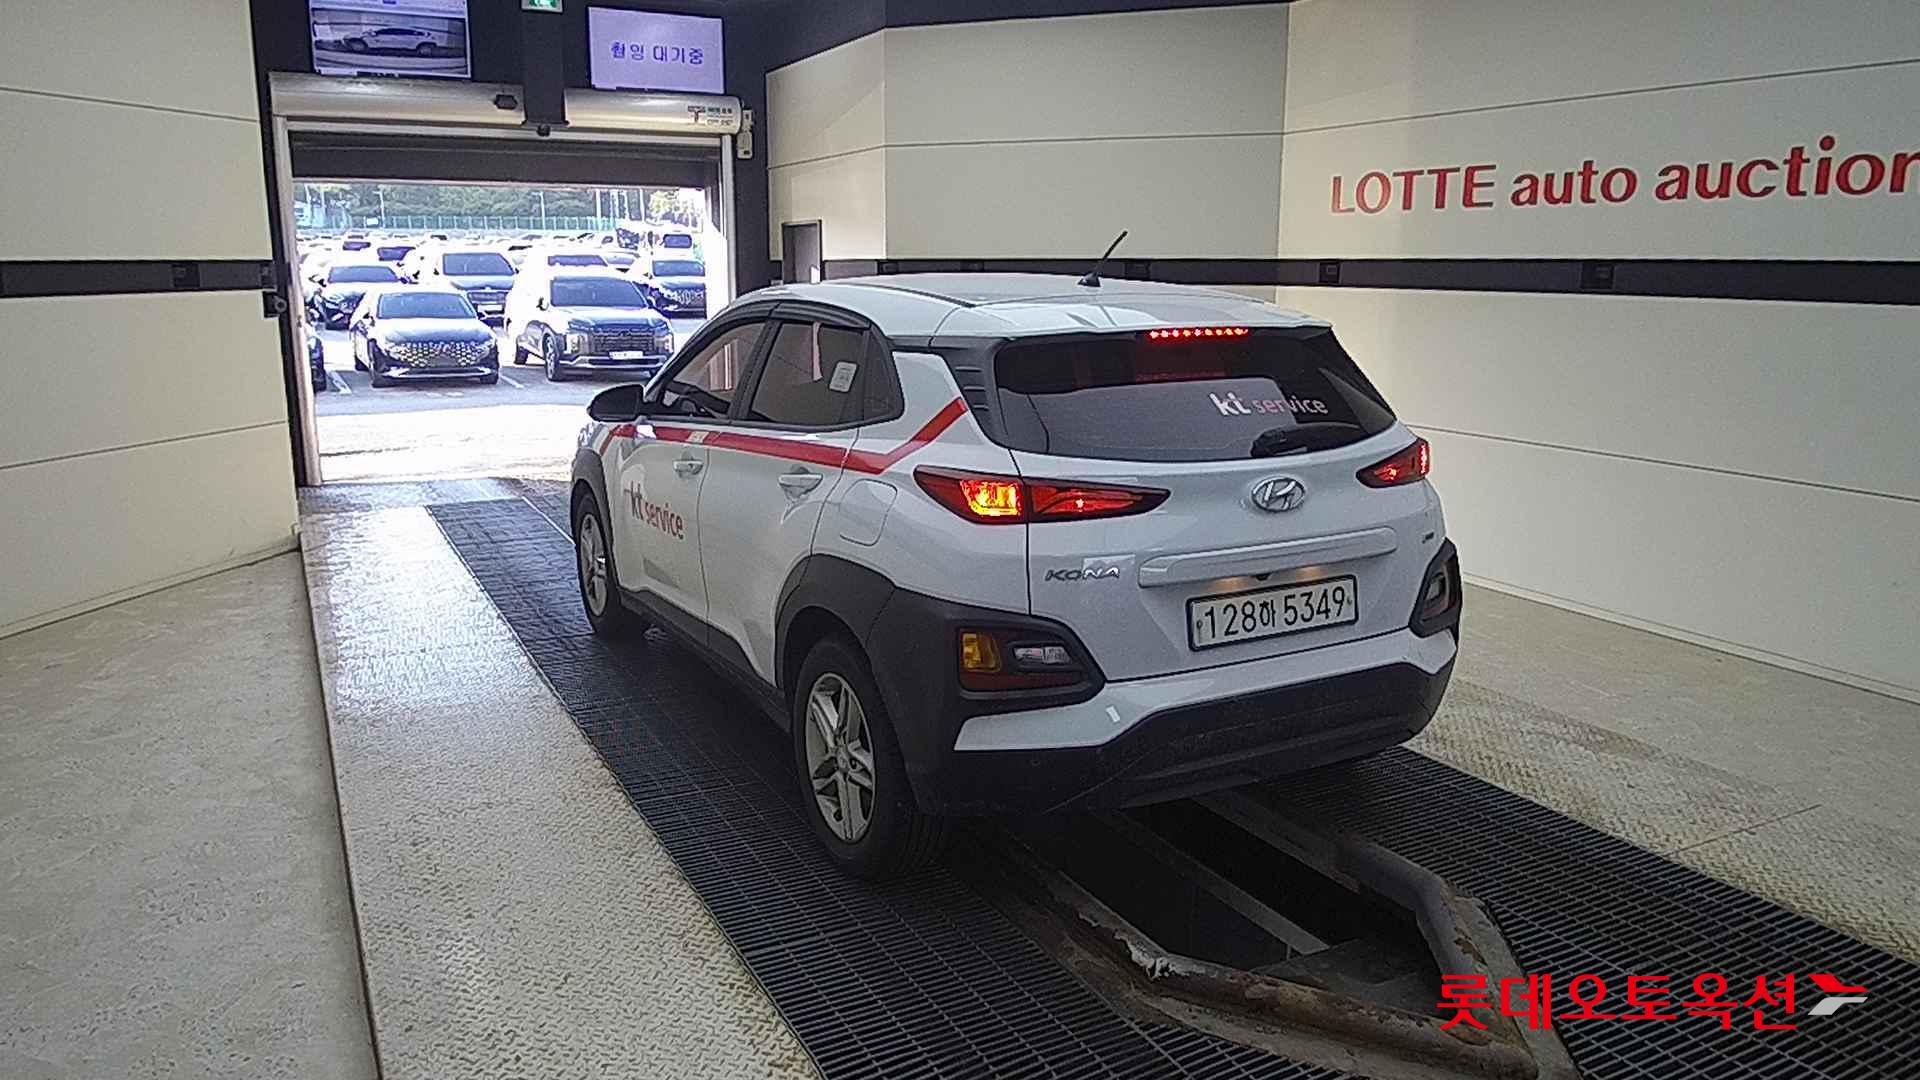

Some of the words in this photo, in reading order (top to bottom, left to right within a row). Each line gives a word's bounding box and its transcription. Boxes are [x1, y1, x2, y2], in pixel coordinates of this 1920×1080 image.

[653, 45, 704, 65] 대기중
[1331, 164, 1497, 214] LOTTE
[1510, 159, 1637, 207] auto
[1209, 392, 1251, 416] kt
[1252, 395, 1328, 415] service
[645, 502, 684, 539] service
[1044, 566, 1120, 581] KONA
